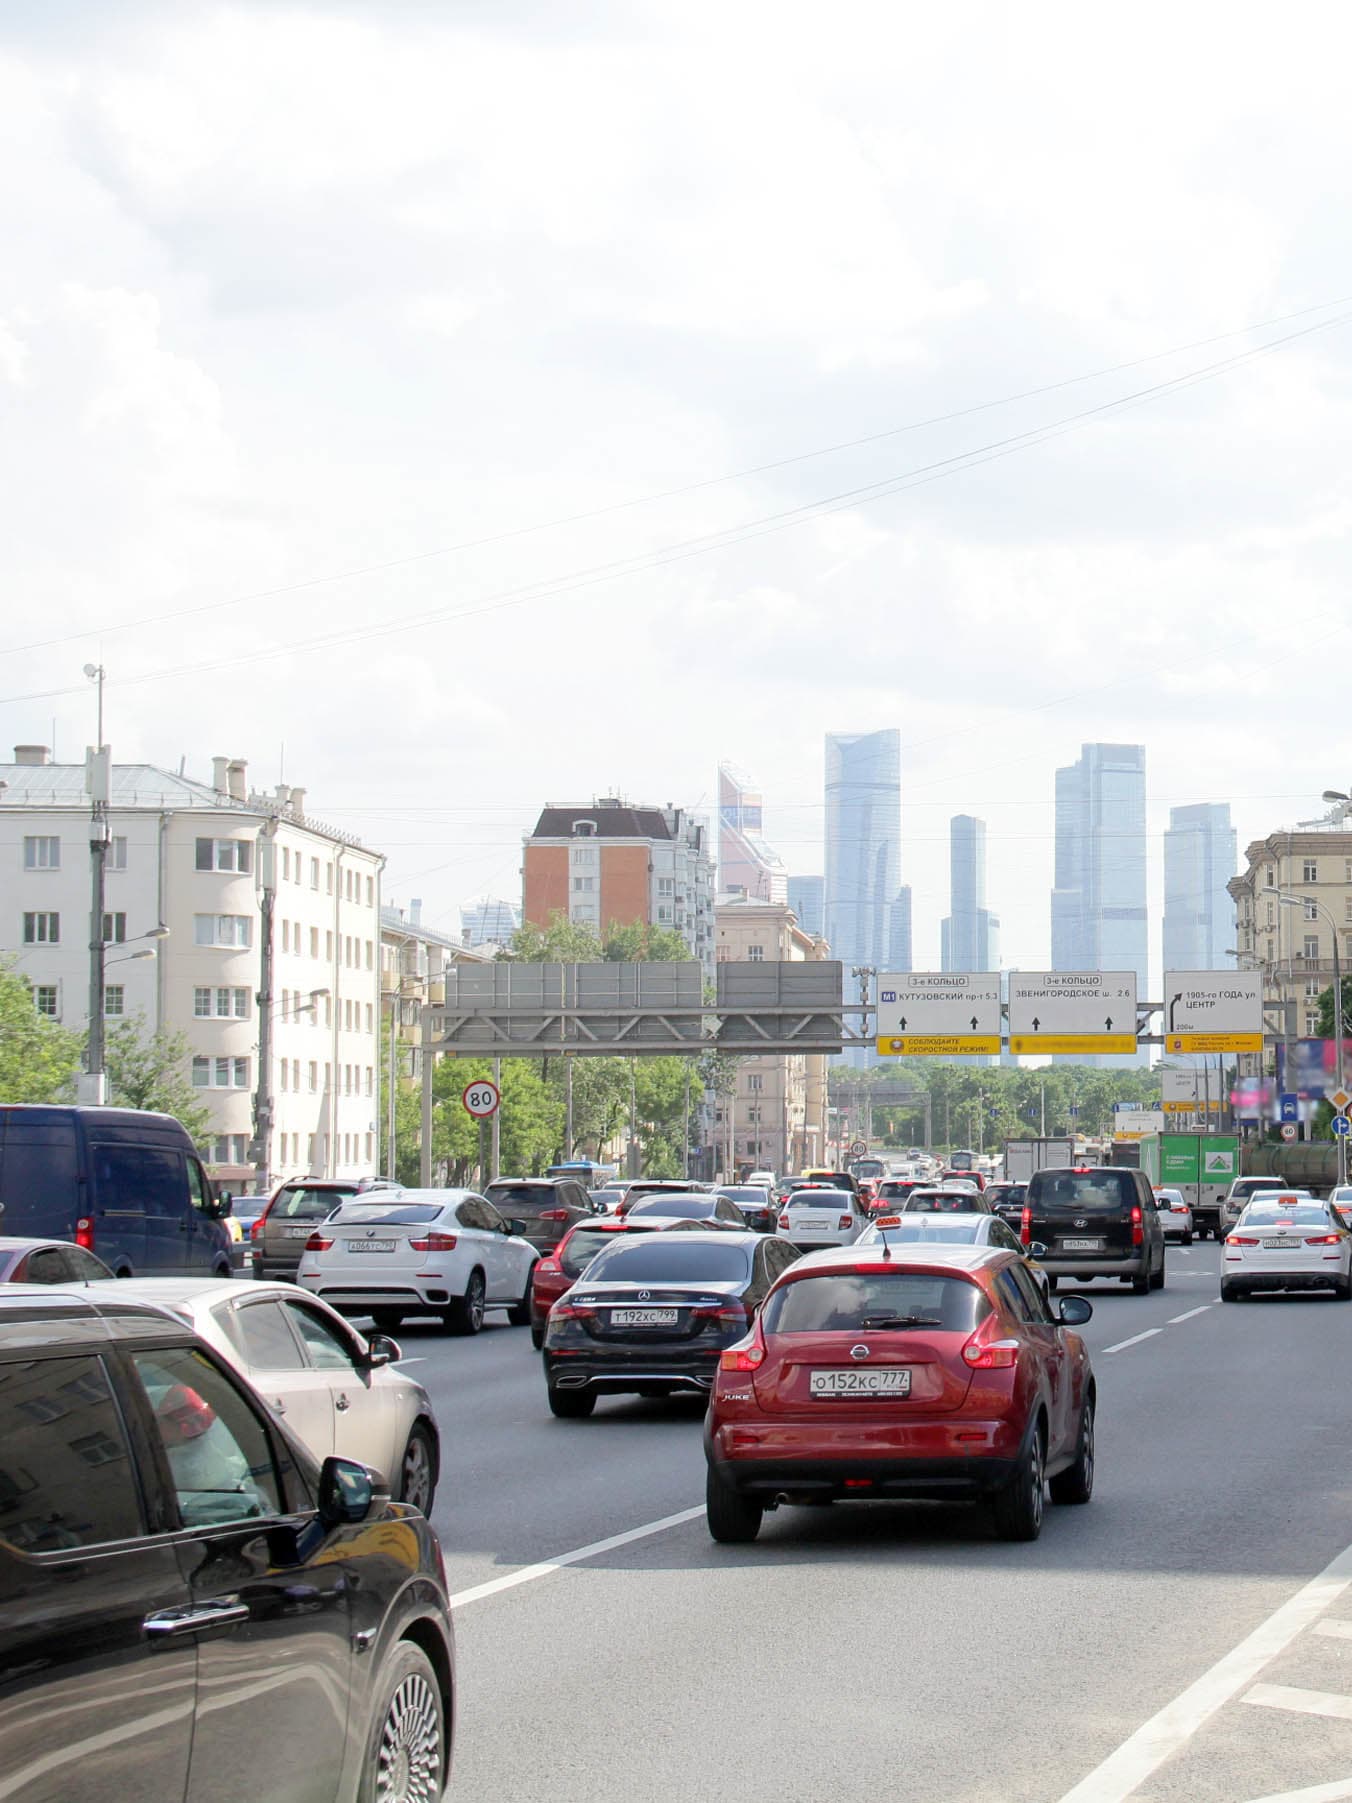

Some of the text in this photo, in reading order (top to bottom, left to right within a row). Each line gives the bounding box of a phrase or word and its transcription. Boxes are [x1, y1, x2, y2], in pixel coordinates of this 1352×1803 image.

[927, 978, 966, 987] КОЛЬЦО
[1061, 977, 1100, 986] КОЛЬЦО
[899, 991, 964, 1001] КУТУЗОВСКИЙ
[1015, 989, 1100, 998] ЗВЕНИГОРОДСКОЕ
[1186, 991, 1217, 999] 1905-го
[1219, 990, 1243, 1000] ГОДА
[1186, 1001, 1216, 1009] ЦЕНТР
[471, 1091, 492, 1107] 80
[882, 1372, 906, 1384] 777
[721, 1394, 751, 1402] JUKE
